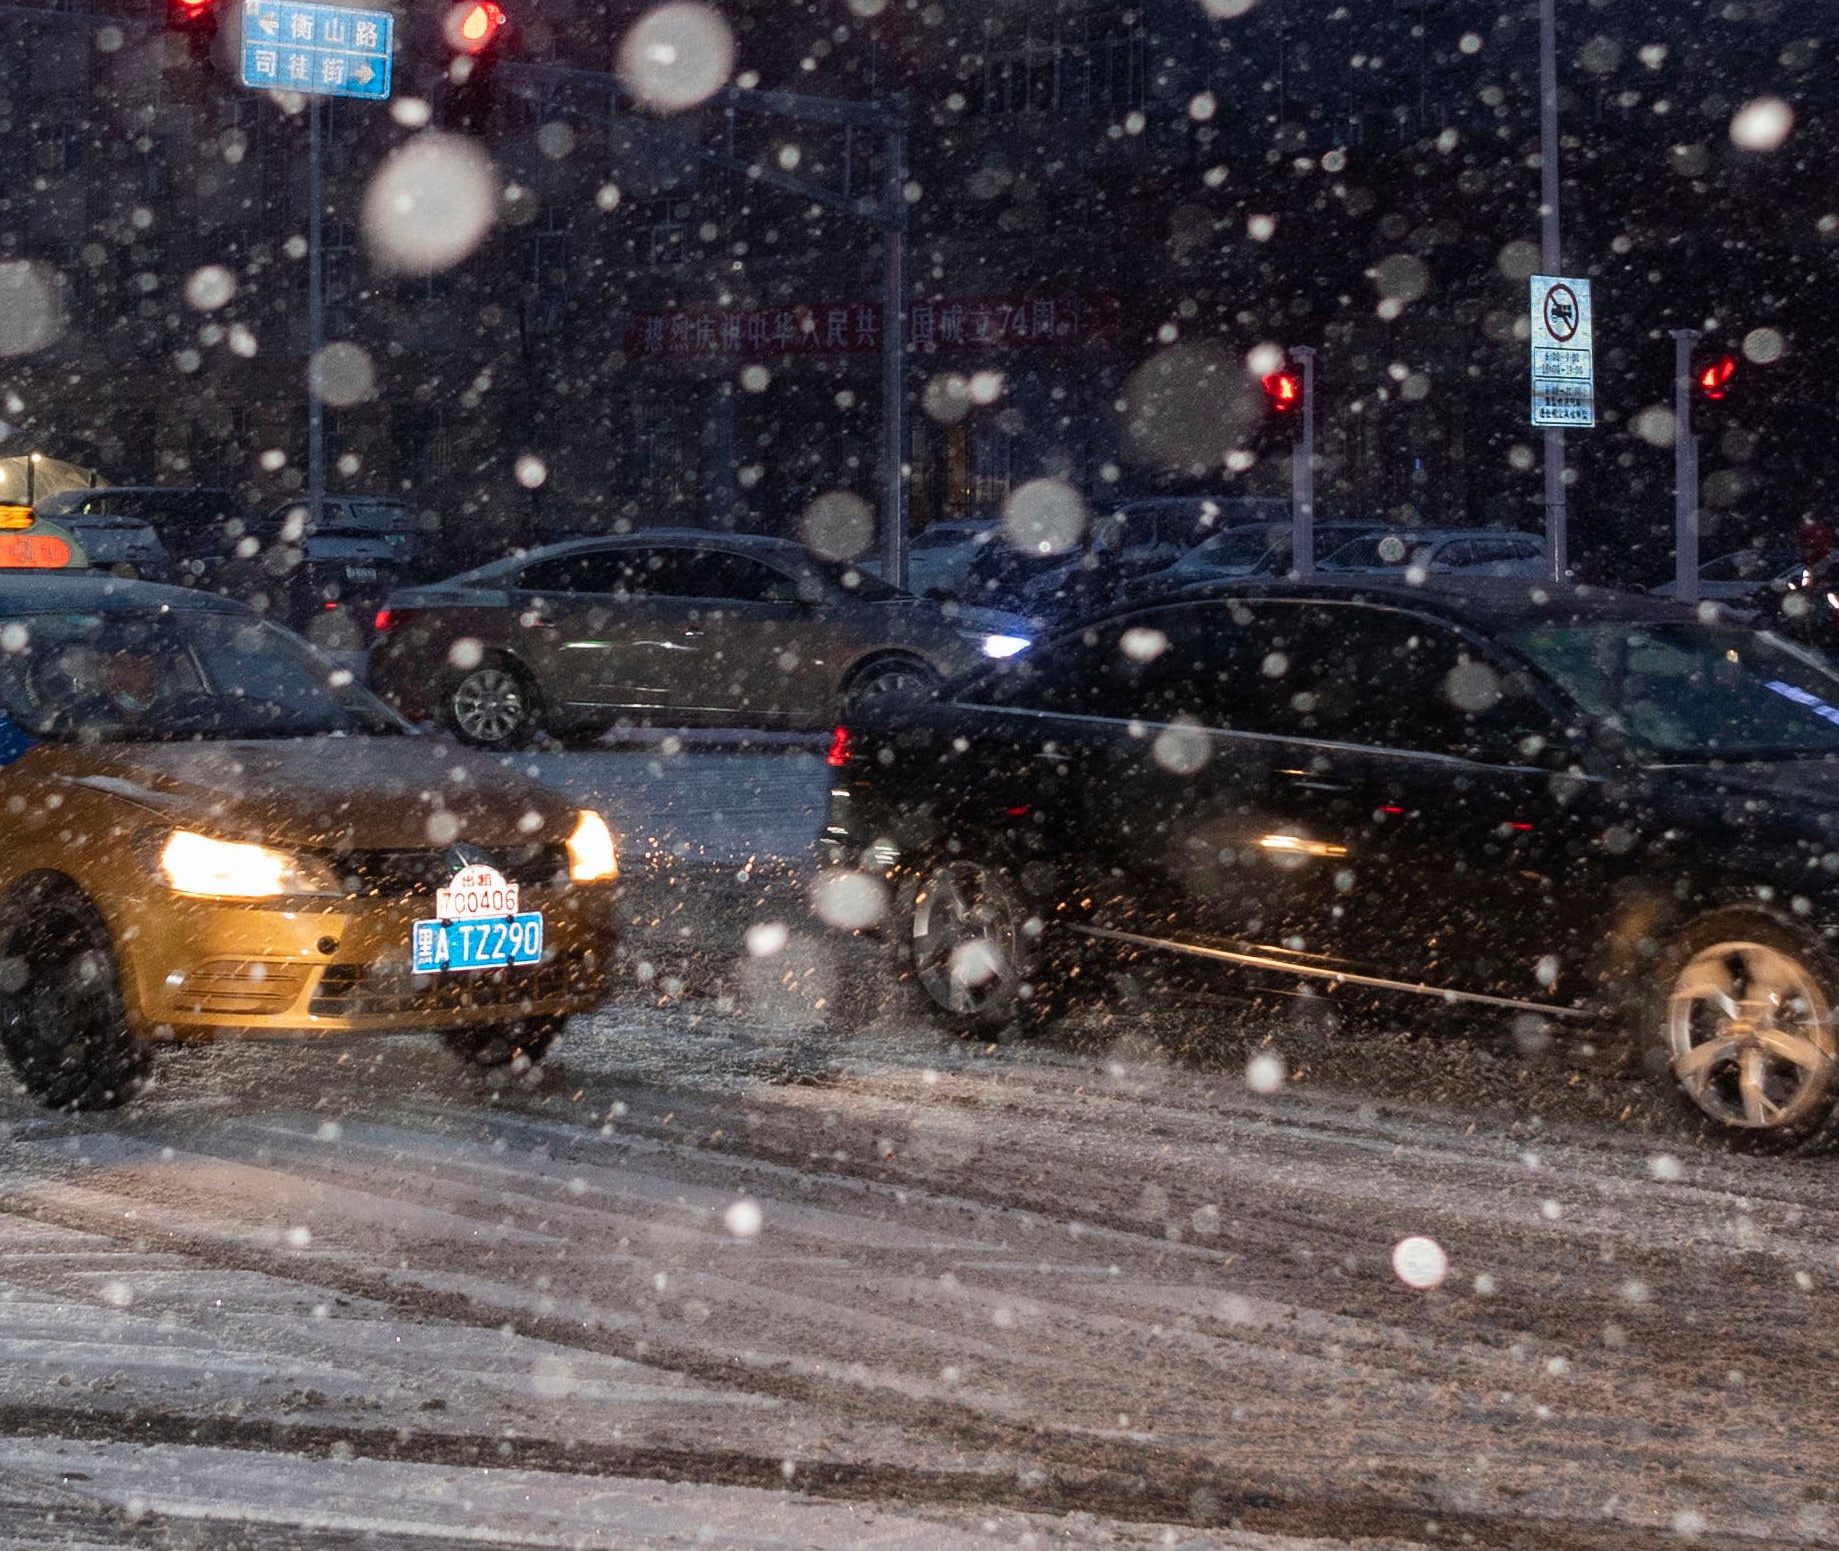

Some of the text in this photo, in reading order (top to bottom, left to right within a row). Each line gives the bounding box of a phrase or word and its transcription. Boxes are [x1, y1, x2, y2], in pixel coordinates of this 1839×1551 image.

[290, 11, 379, 48] 衡山路
[254, 50, 345, 85] 司徒街
[443, 889, 516, 914] 700406
